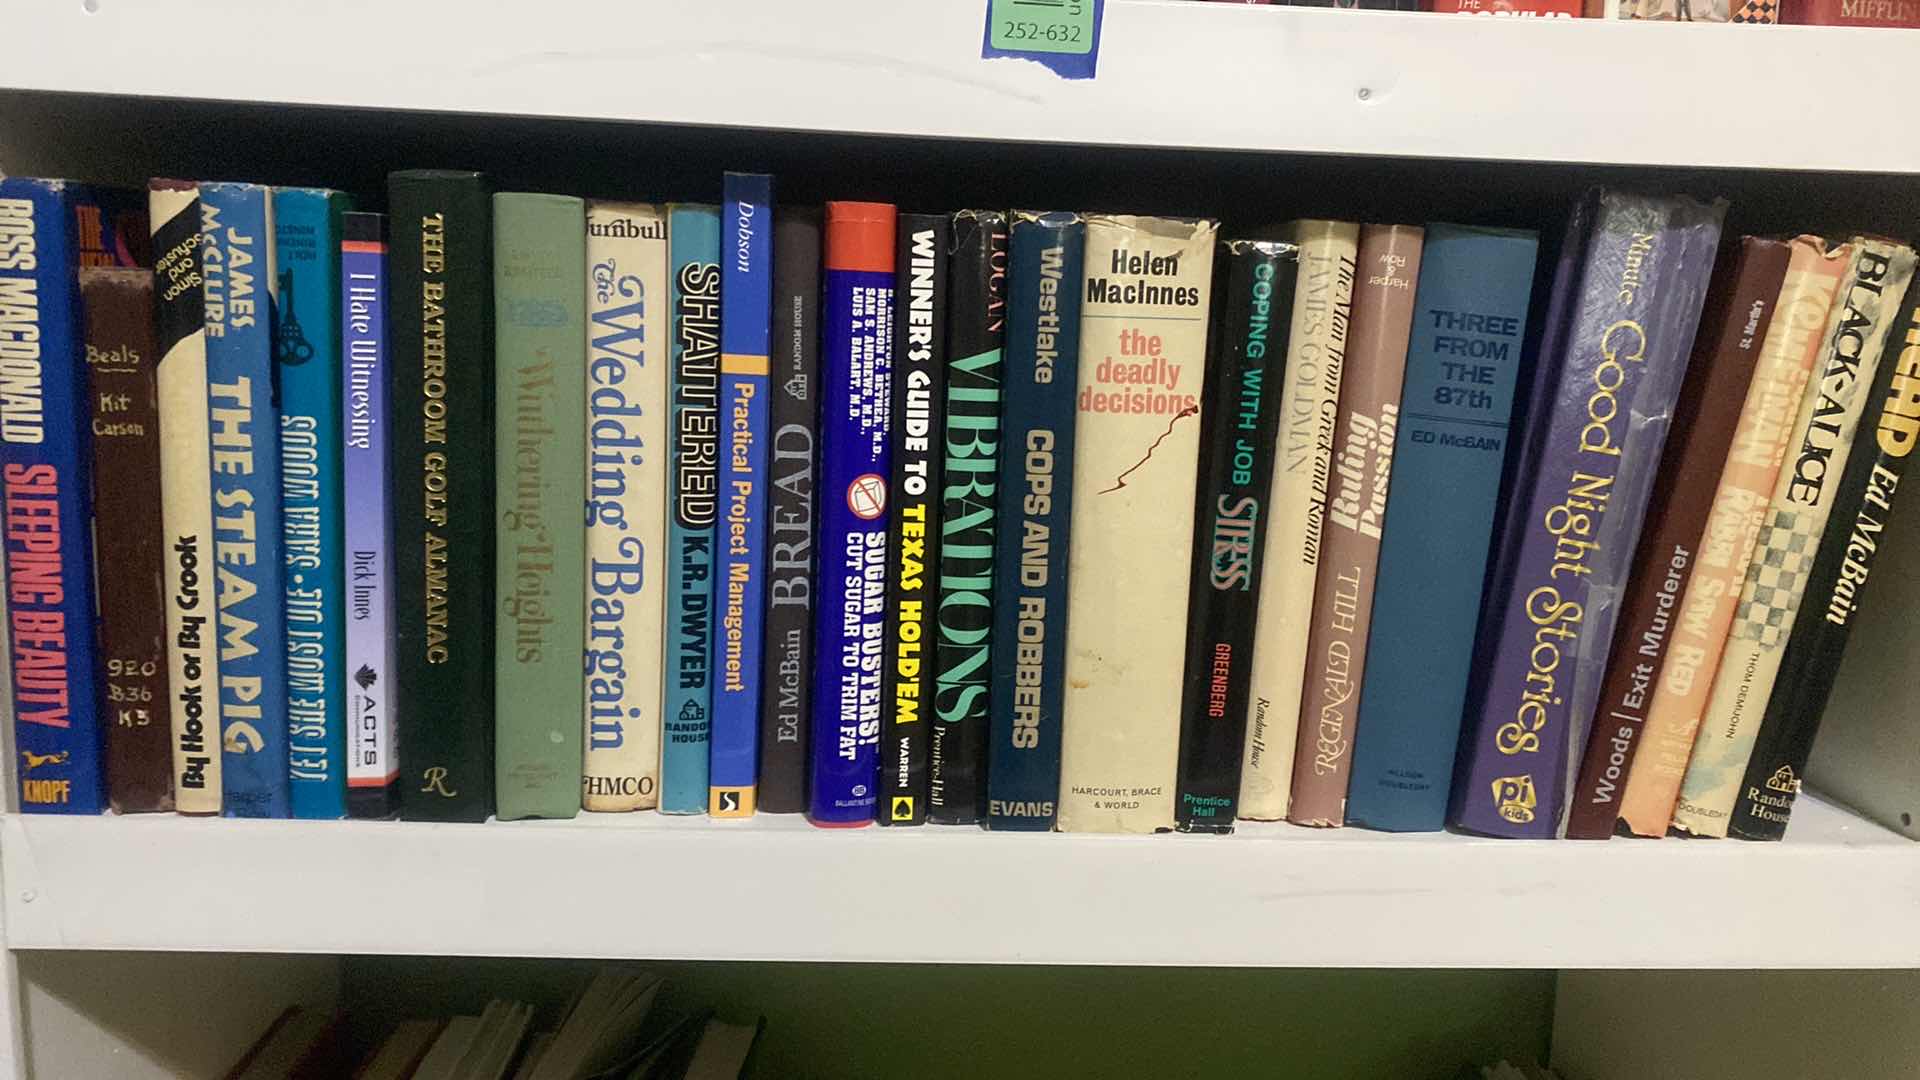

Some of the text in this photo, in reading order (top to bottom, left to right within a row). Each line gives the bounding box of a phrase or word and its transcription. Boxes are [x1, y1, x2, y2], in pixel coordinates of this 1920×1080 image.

[1004, 21, 1081, 42] 252-632
[168, 257, 195, 282] and
[737, 201, 755, 273] Dobson
[1111, 249, 1178, 276] Helen
[1379, 253, 1406, 268] Row
[1618, 232, 1654, 305] Minute
[162, 271, 204, 302] Simon
[227, 227, 255, 328] JAMES
[592, 258, 616, 304] The
[852, 286, 864, 316] LUIS
[865, 287, 876, 315] SAM
[987, 232, 1007, 333] LOGAN
[1087, 278, 1199, 306] MacInnes
[1368, 274, 1409, 290] Harper
[0, 199, 43, 444] ROSS MACDONALD
[350, 287, 376, 334] Hate
[851, 320, 863, 332] A.
[864, 319, 874, 331] S.
[875, 288, 887, 354] MORRISON
[1035, 247, 1065, 384] Westlake
[1119, 328, 1163, 356] the
[1428, 309, 1519, 337] THREE
[86, 345, 140, 364] Beals
[793, 328, 802, 370] RANDOM
[861, 335, 874, 400] ANDREWS,
[874, 358, 885, 370] C.
[1095, 356, 1181, 390] deadly
[1232, 263, 1275, 486] COPING WITH JOB
[1287, 252, 1332, 475] JAMES GOLDMAN
[1433, 335, 1510, 361] FROM
[1442, 361, 1496, 385] THE
[100, 393, 131, 412] Kit
[346, 341, 377, 449] Witnessing
[679, 262, 722, 525] SHATTERED
[849, 393, 861, 421] M.D.
[872, 374, 884, 427] BETHEA,
[1078, 385, 1196, 415] decisions
[1303, 255, 1356, 566] The Man from Greek and Roman
[1433, 386, 1493, 410] 87th
[422, 213, 448, 664] THE BATHROOM GOLF ALMANAC
[1329, 411, 1378, 531] Ruling
[1410, 430, 1502, 452] ED McBAIN
[896, 230, 935, 724] WINNER'S GUIDE TO TEXAS HOLD'EM
[1358, 403, 1399, 540] Passion
[584, 275, 644, 751] Wedding Bargain
[724, 383, 755, 692] Practical Project Management
[772, 424, 814, 609] BREAD
[935, 347, 1001, 722] VIBRATIONS
[1496, 319, 1646, 755] Good Night Stories
[1825, 463, 1900, 626] Ed McBain
[4, 464, 71, 729] SLEEPING BEAUTY
[211, 376, 265, 753] THE STEAM PIG
[353, 551, 376, 621] Dick Innes
[1012, 429, 1055, 749] COPS AND ROBBERS
[281, 415, 328, 782] YET SHE MUST DIE SARAH WOODS
[680, 536, 710, 689] K.R. DWYER
[108, 659, 156, 677] 920
[174, 535, 211, 788] By Hook or By Crook
[839, 532, 864, 760] CUT SUGAR TO TRIM FAT
[857, 531, 886, 746] SUGAR BUSTERS!
[1314, 566, 1361, 776] REGINALD HILL
[107, 682, 153, 702] B36
[777, 628, 801, 742] Ed McBain
[1208, 643, 1232, 718] GREENBERG
[1592, 545, 1690, 804] Woods Exit Murderer
[1725, 652, 1761, 740] THOM DEMIJOHN
[363, 695, 377, 766] ACTS
[899, 737, 910, 788] WARREN
[1250, 697, 1271, 769] Random House
[23, 780, 71, 803] KNOPF
[930, 726, 946, 806] Prentice-Hall
[1071, 786, 1162, 796] HARCOURT, BRACE
[1500, 777, 1530, 803] pi
[990, 800, 1053, 817] EVANS
[1094, 801, 1140, 809] & WORLD
[1183, 793, 1231, 807] Prentice
[1192, 807, 1216, 817] Hall
[1503, 806, 1530, 821] kids
